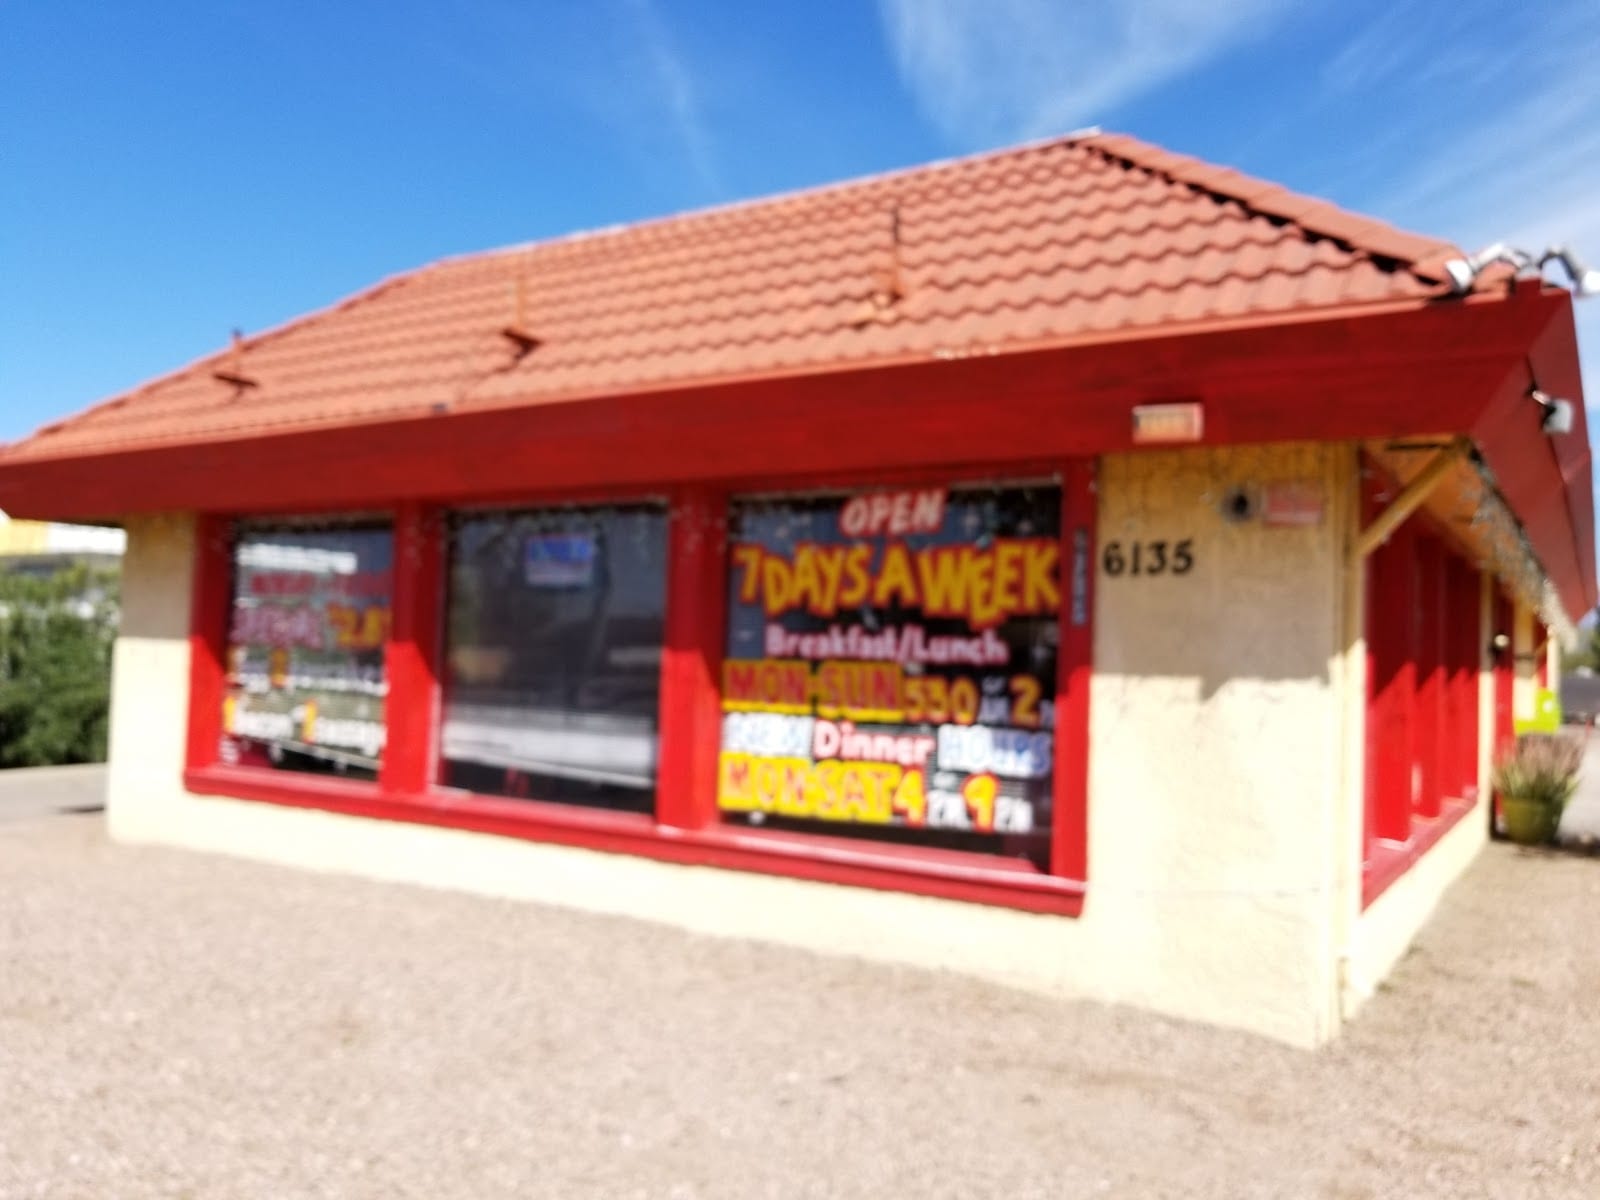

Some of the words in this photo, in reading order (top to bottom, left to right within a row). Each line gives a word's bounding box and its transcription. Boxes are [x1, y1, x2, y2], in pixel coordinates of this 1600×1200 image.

[838, 489, 948, 536] OPEN
[1103, 538, 1194, 577] 6135
[734, 543, 765, 604] 7
[763, 543, 873, 618] DAYS
[871, 544, 924, 608] A
[917, 538, 1060, 631] WEEK
[766, 623, 1009, 663] Breakfast/Lunch
[1010, 674, 1042, 726] 2
[813, 720, 935, 766] Dinner
[894, 767, 926, 827] 4
[962, 772, 999, 833] 9
